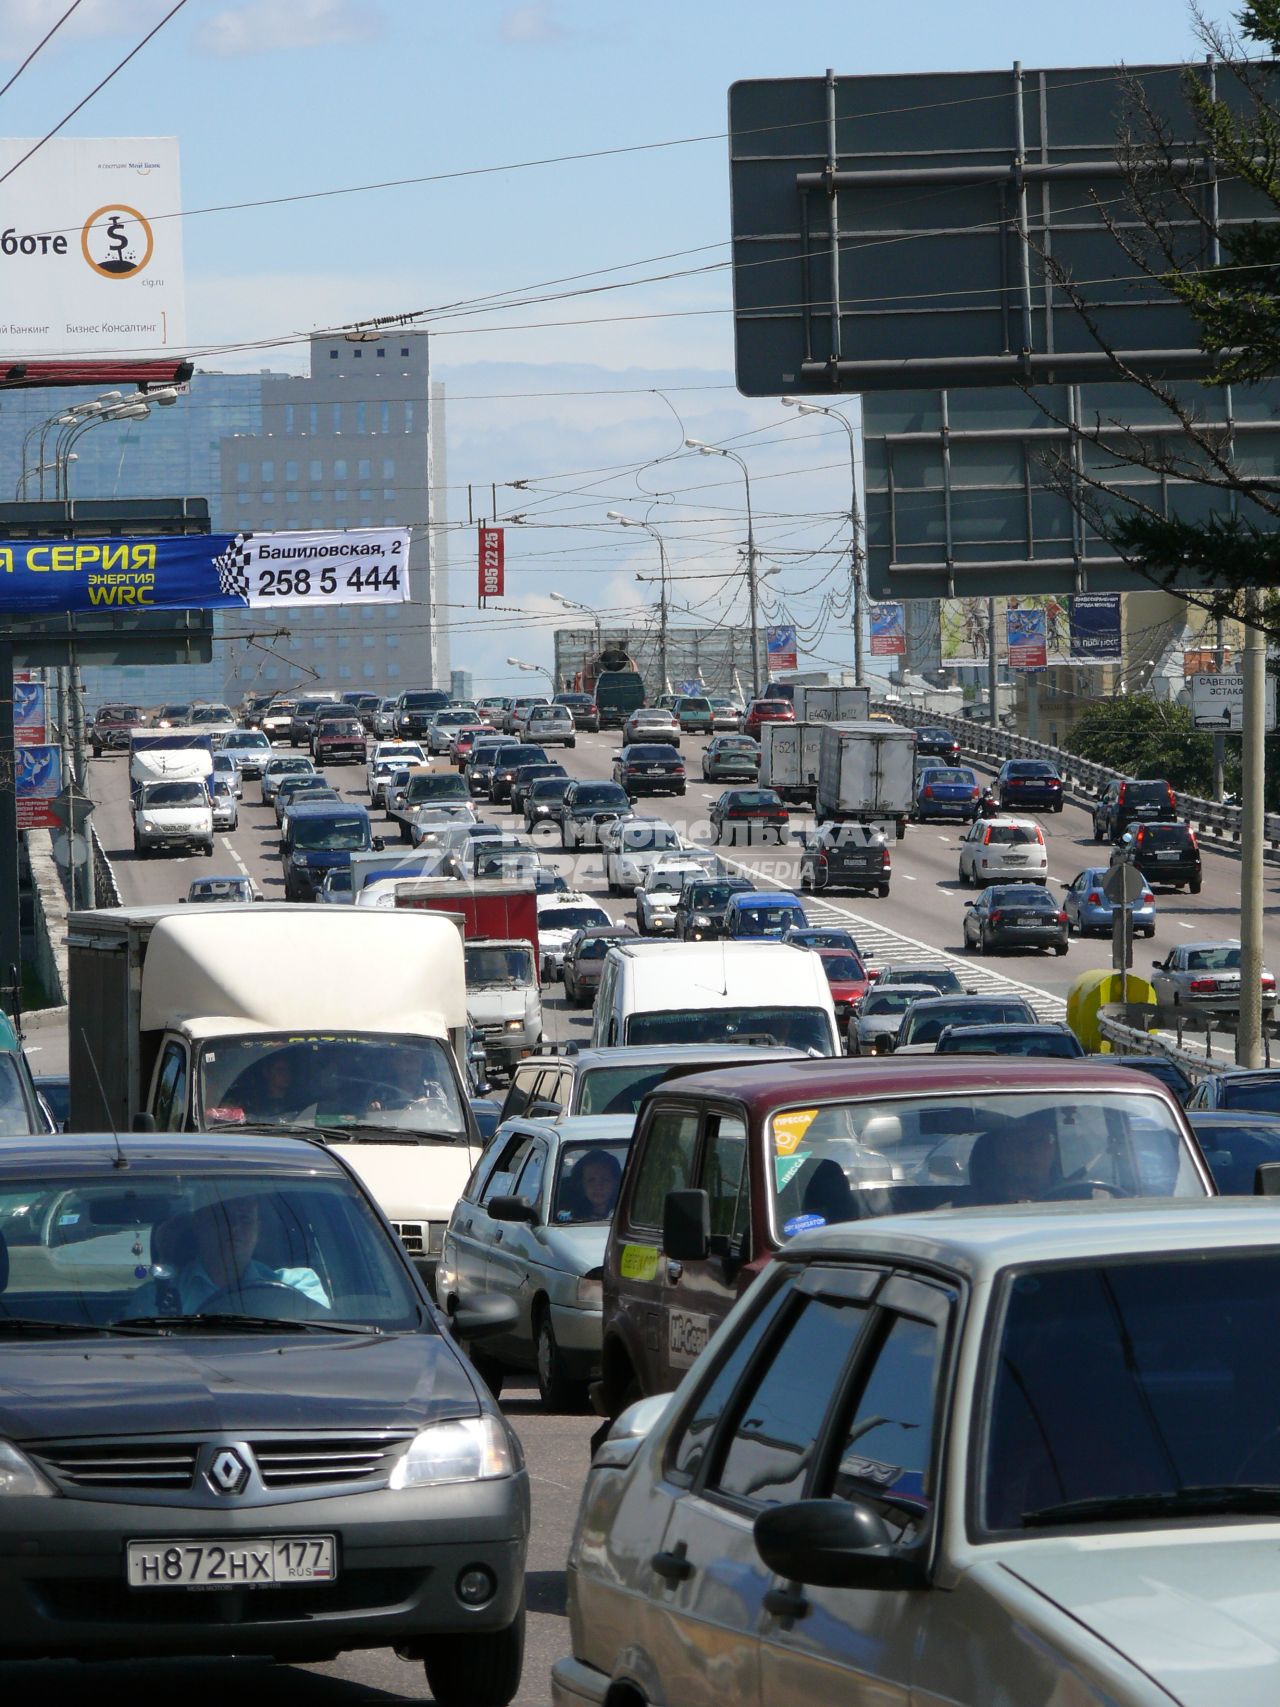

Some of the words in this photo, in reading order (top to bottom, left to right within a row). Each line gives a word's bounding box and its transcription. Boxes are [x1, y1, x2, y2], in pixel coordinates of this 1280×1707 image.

[141, 278, 164, 288] cig.ru
[10, 325, 50, 334] Банкинг
[66, 323, 100, 333] Бизнес
[101, 322, 157, 333] Консалтинг
[484, 532, 499, 548] 25
[26, 544, 157, 572] СЕРИЯ
[258, 543, 385, 559] Башиловская,
[391, 540, 402, 554] 2
[484, 550, 499, 566] 22
[88, 573, 155, 585] ЭНЕРГИЯ
[258, 568, 311, 596] 258
[320, 567, 337, 594] 5
[347, 564, 400, 592] 444
[484, 568, 499, 593] 995
[88, 586, 155, 605] WRC
[775, 1114, 812, 1126] ПРЕССА
[780, 1158, 806, 1184] ПРЕССА
[141, 1546, 270, 1580] Н872НХ
[277, 1541, 326, 1568] 177
[288, 1567, 312, 1577] RUS
